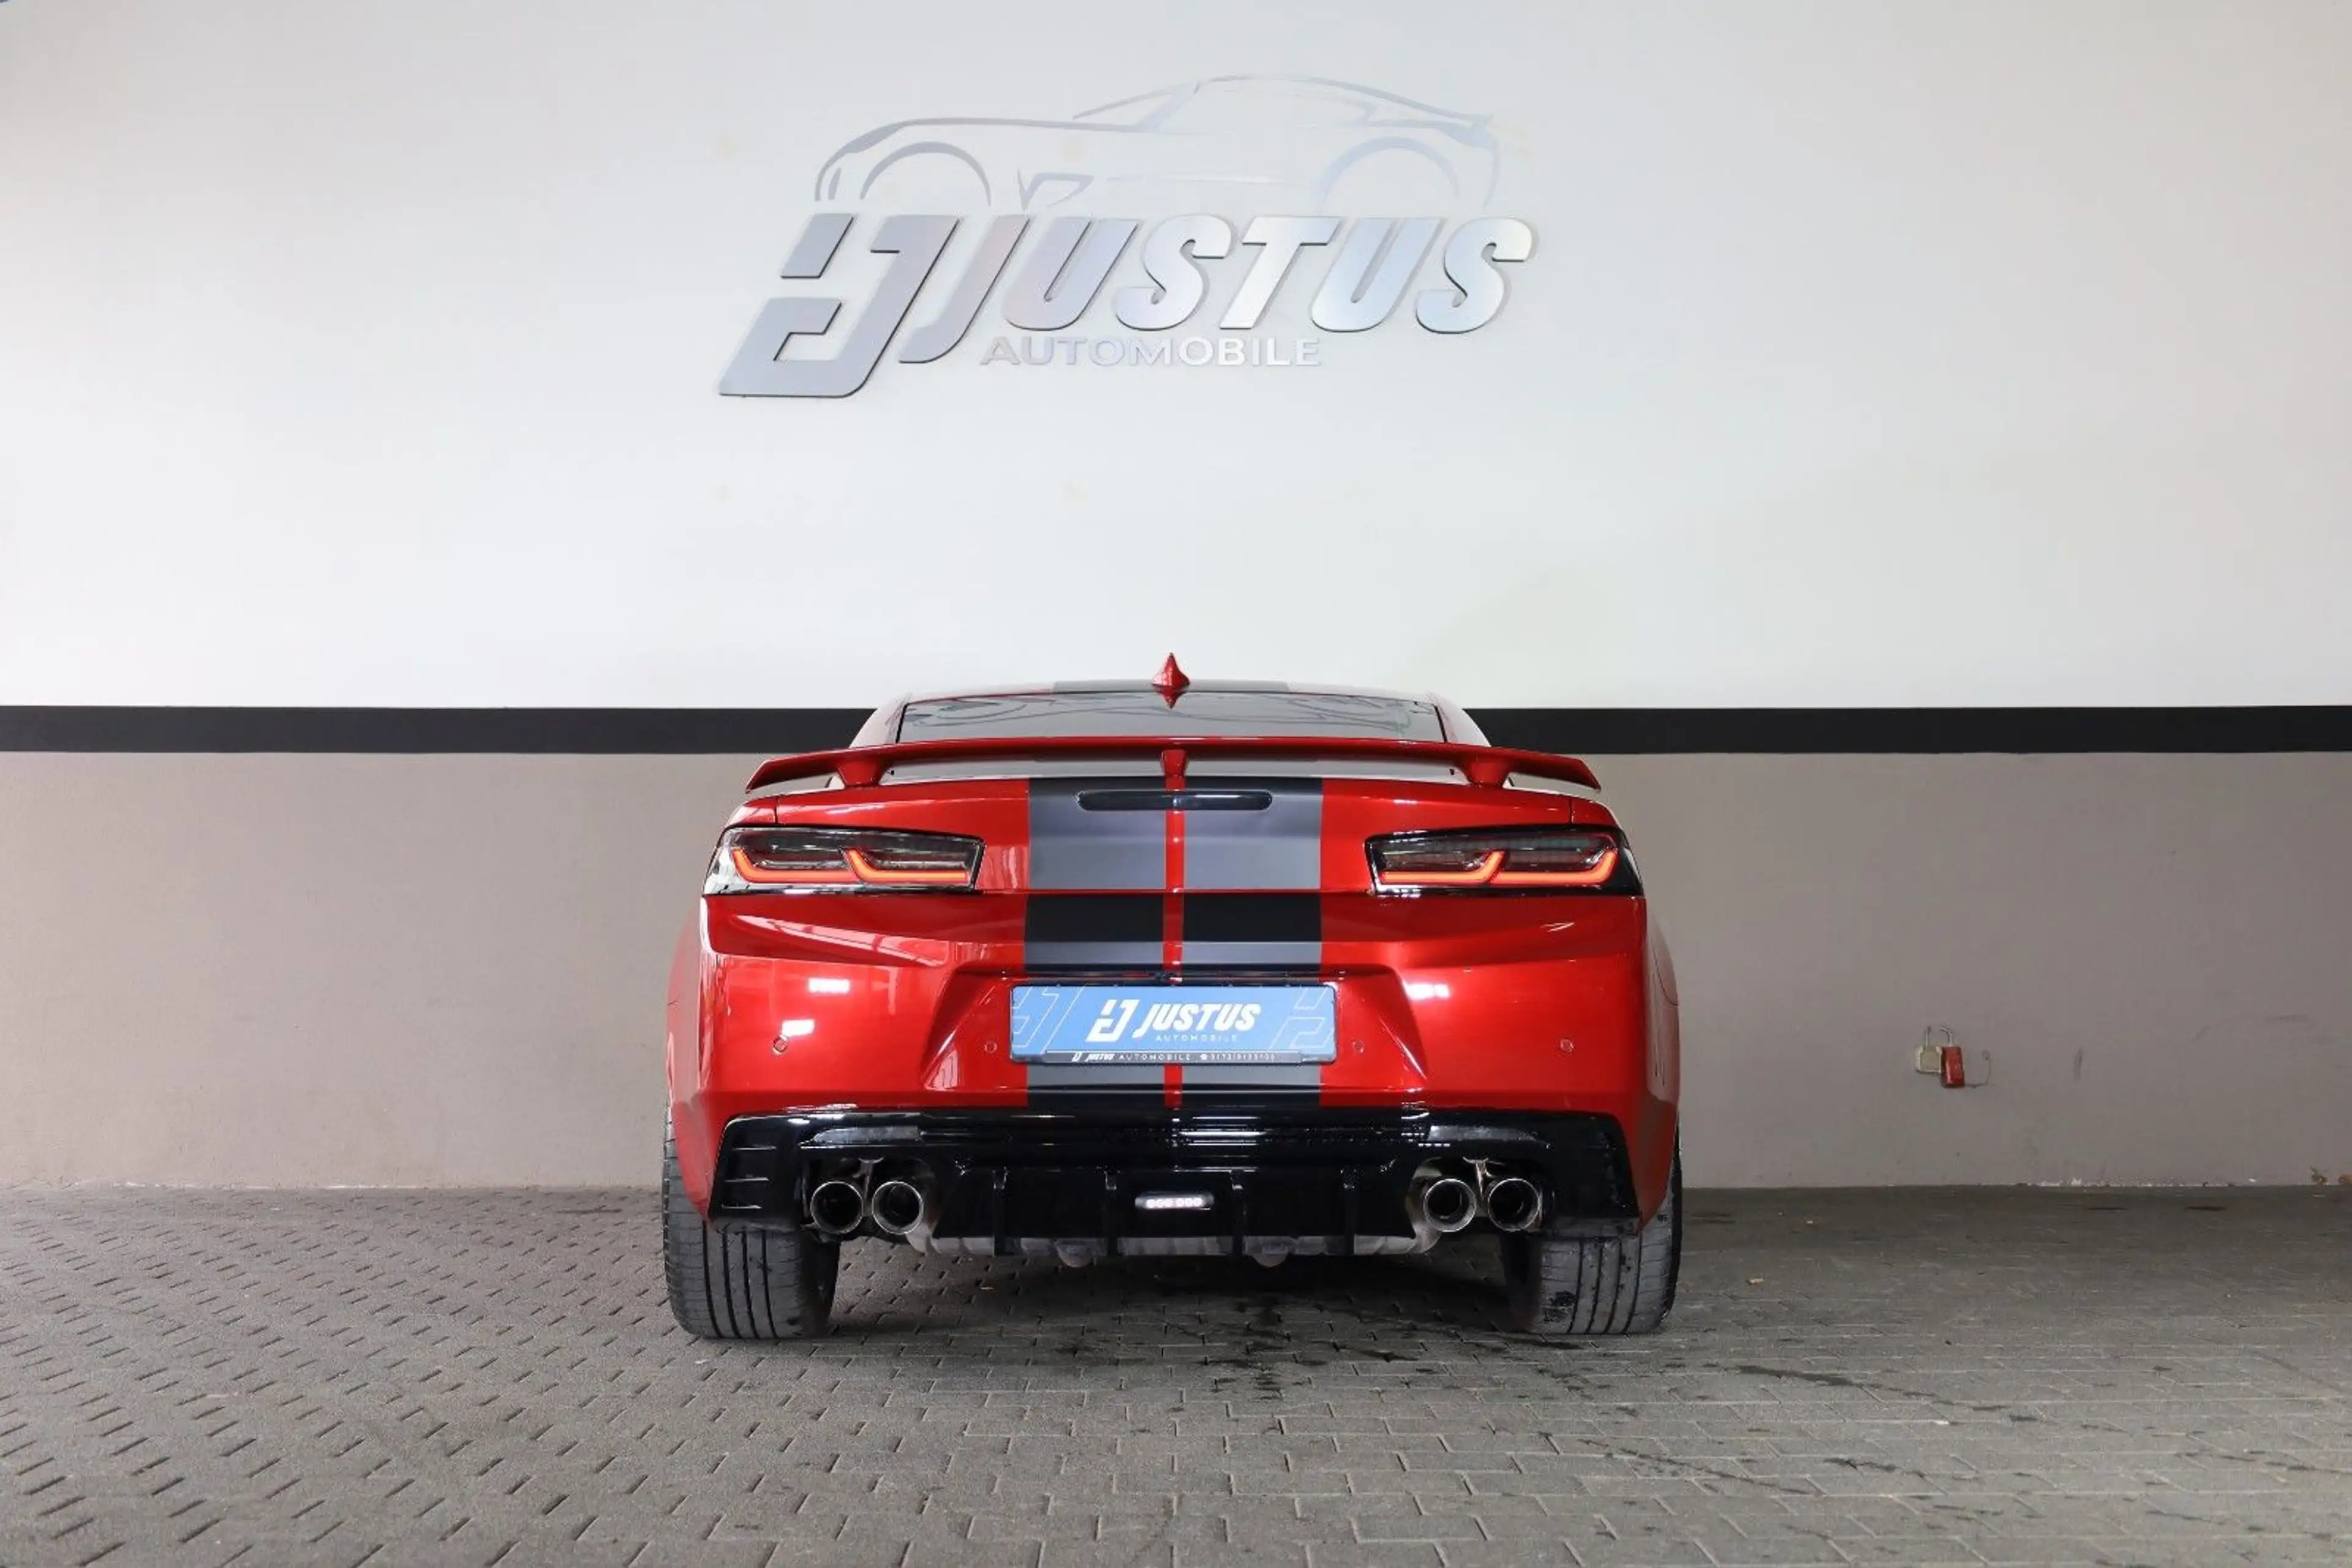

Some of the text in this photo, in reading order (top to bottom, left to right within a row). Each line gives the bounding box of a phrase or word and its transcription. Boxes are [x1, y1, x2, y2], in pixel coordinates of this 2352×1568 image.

[899, 214, 1532, 363] JUSTUS
[980, 336, 1321, 366] AUTOMOBILE
[1132, 1003, 1262, 1038] JUSTUS
